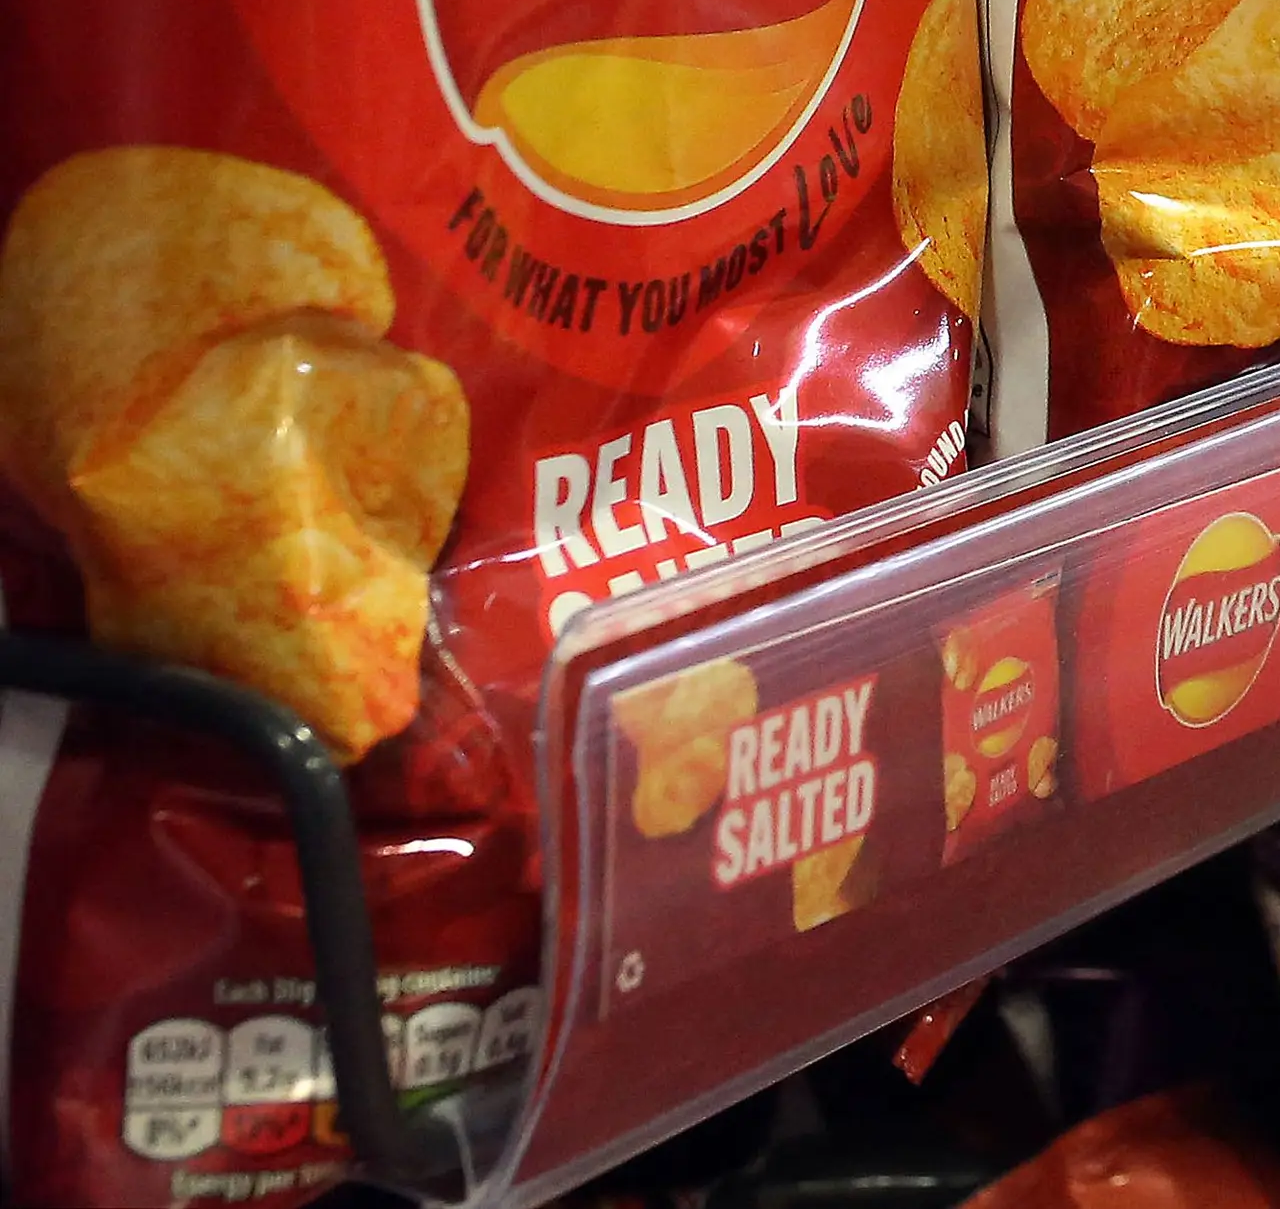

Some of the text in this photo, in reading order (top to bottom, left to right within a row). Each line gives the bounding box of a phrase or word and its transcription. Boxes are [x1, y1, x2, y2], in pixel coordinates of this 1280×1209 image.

[447, 184, 509, 283] FOR
[503, 244, 608, 332] WHAT
[616, 271, 692, 337] YOU
[695, 205, 788, 315] MOST
[534, 387, 799, 579] READY
[917, 409, 968, 489] OUND
[729, 680, 874, 801] READY
[714, 759, 876, 886] SALTED
